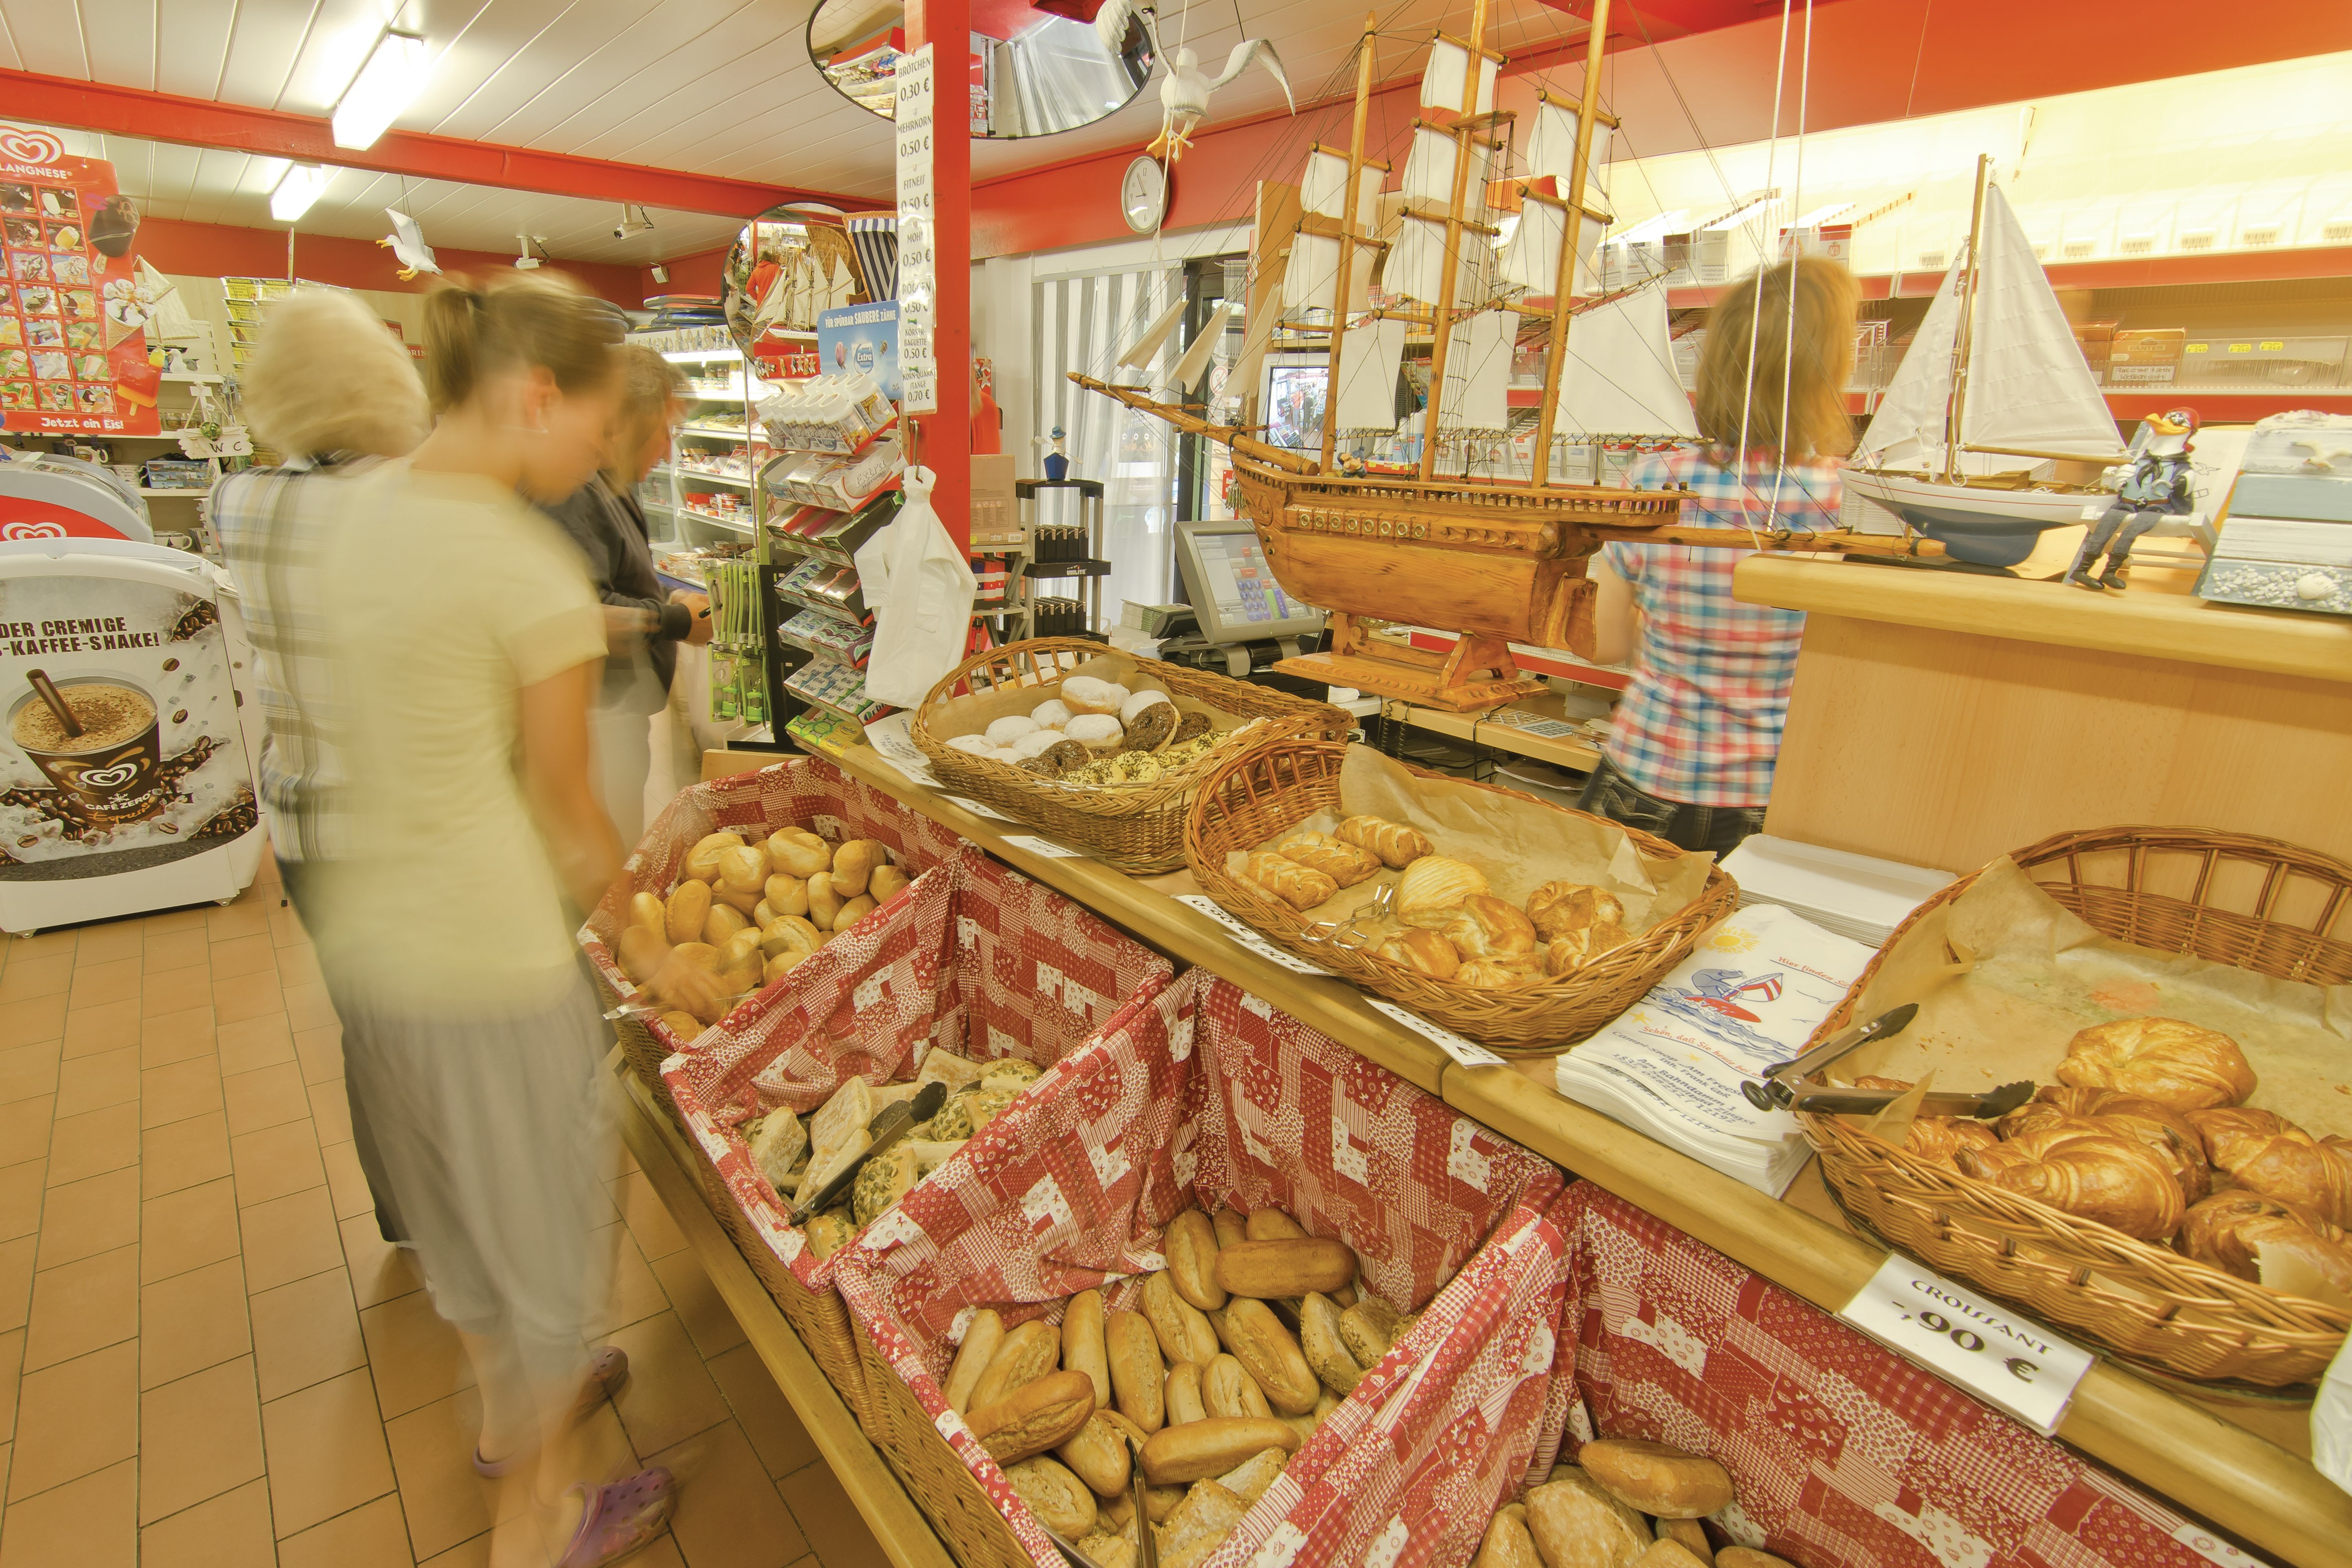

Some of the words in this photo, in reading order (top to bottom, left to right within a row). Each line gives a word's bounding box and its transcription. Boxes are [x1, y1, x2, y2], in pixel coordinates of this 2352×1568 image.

[898, 56, 931, 78] BRÖTCHEN
[900, 82, 920, 102] 0,30
[924, 77, 930, 92] €
[897, 115, 932, 134] MEHRKORN
[901, 139, 920, 157] 0,50
[924, 135, 929, 150] €
[904, 174, 925, 190] FITNESS
[901, 197, 920, 214] 050
[924, 193, 929, 207] €
[903, 251, 922, 267] 0,50
[925, 248, 931, 262] €
[825, 317, 833, 328] FÜR
[834, 315, 854, 327] SPÜRBAR
[854, 310, 879, 324] SAUBERE
[880, 308, 896, 321] ZÄHNE
[904, 338, 927, 347] BAGUETTE
[857, 353, 872, 362] Extra
[904, 348, 920, 360] 0,50
[922, 348, 927, 358] €
[910, 380, 926, 390] STANGE
[908, 390, 923, 402] 0,70
[925, 389, 930, 399] €
[41, 417, 80, 428] Jetzt
[83, 418, 101, 428] ein
[104, 419, 124, 429] Eis!
[41, 617, 127, 637] CREMIGE
[119, 793, 151, 809] ZERO
[1778, 956, 1799, 967] Hier
[1801, 965, 1834, 980] finden
[1456, 1046, 1476, 1056] €
[1643, 1026, 1673, 1038] Schön,
[1676, 1035, 1696, 1044] daß
[1697, 1041, 1711, 1051] Sie
[1712, 1051, 1735, 1066] heute
[1659, 1058, 1677, 1070] Inh.
[1680, 1069, 1709, 1087] Frank
[1710, 1086, 1731, 1098] GbR
[1686, 1066, 1705, 1077] Am
[1638, 1059, 1657, 1069] Am
[1659, 1070, 1725, 1106] Bahndamm
[1695, 1103, 1737, 1123] 12192
[1714, 1107, 1757, 1125] Zingst
[1679, 1113, 1719, 1134] 12192
[1911, 1280, 2054, 1354] CROISSANT
[1892, 1301, 1985, 1351] -,90
[2003, 1357, 2040, 1384] €
